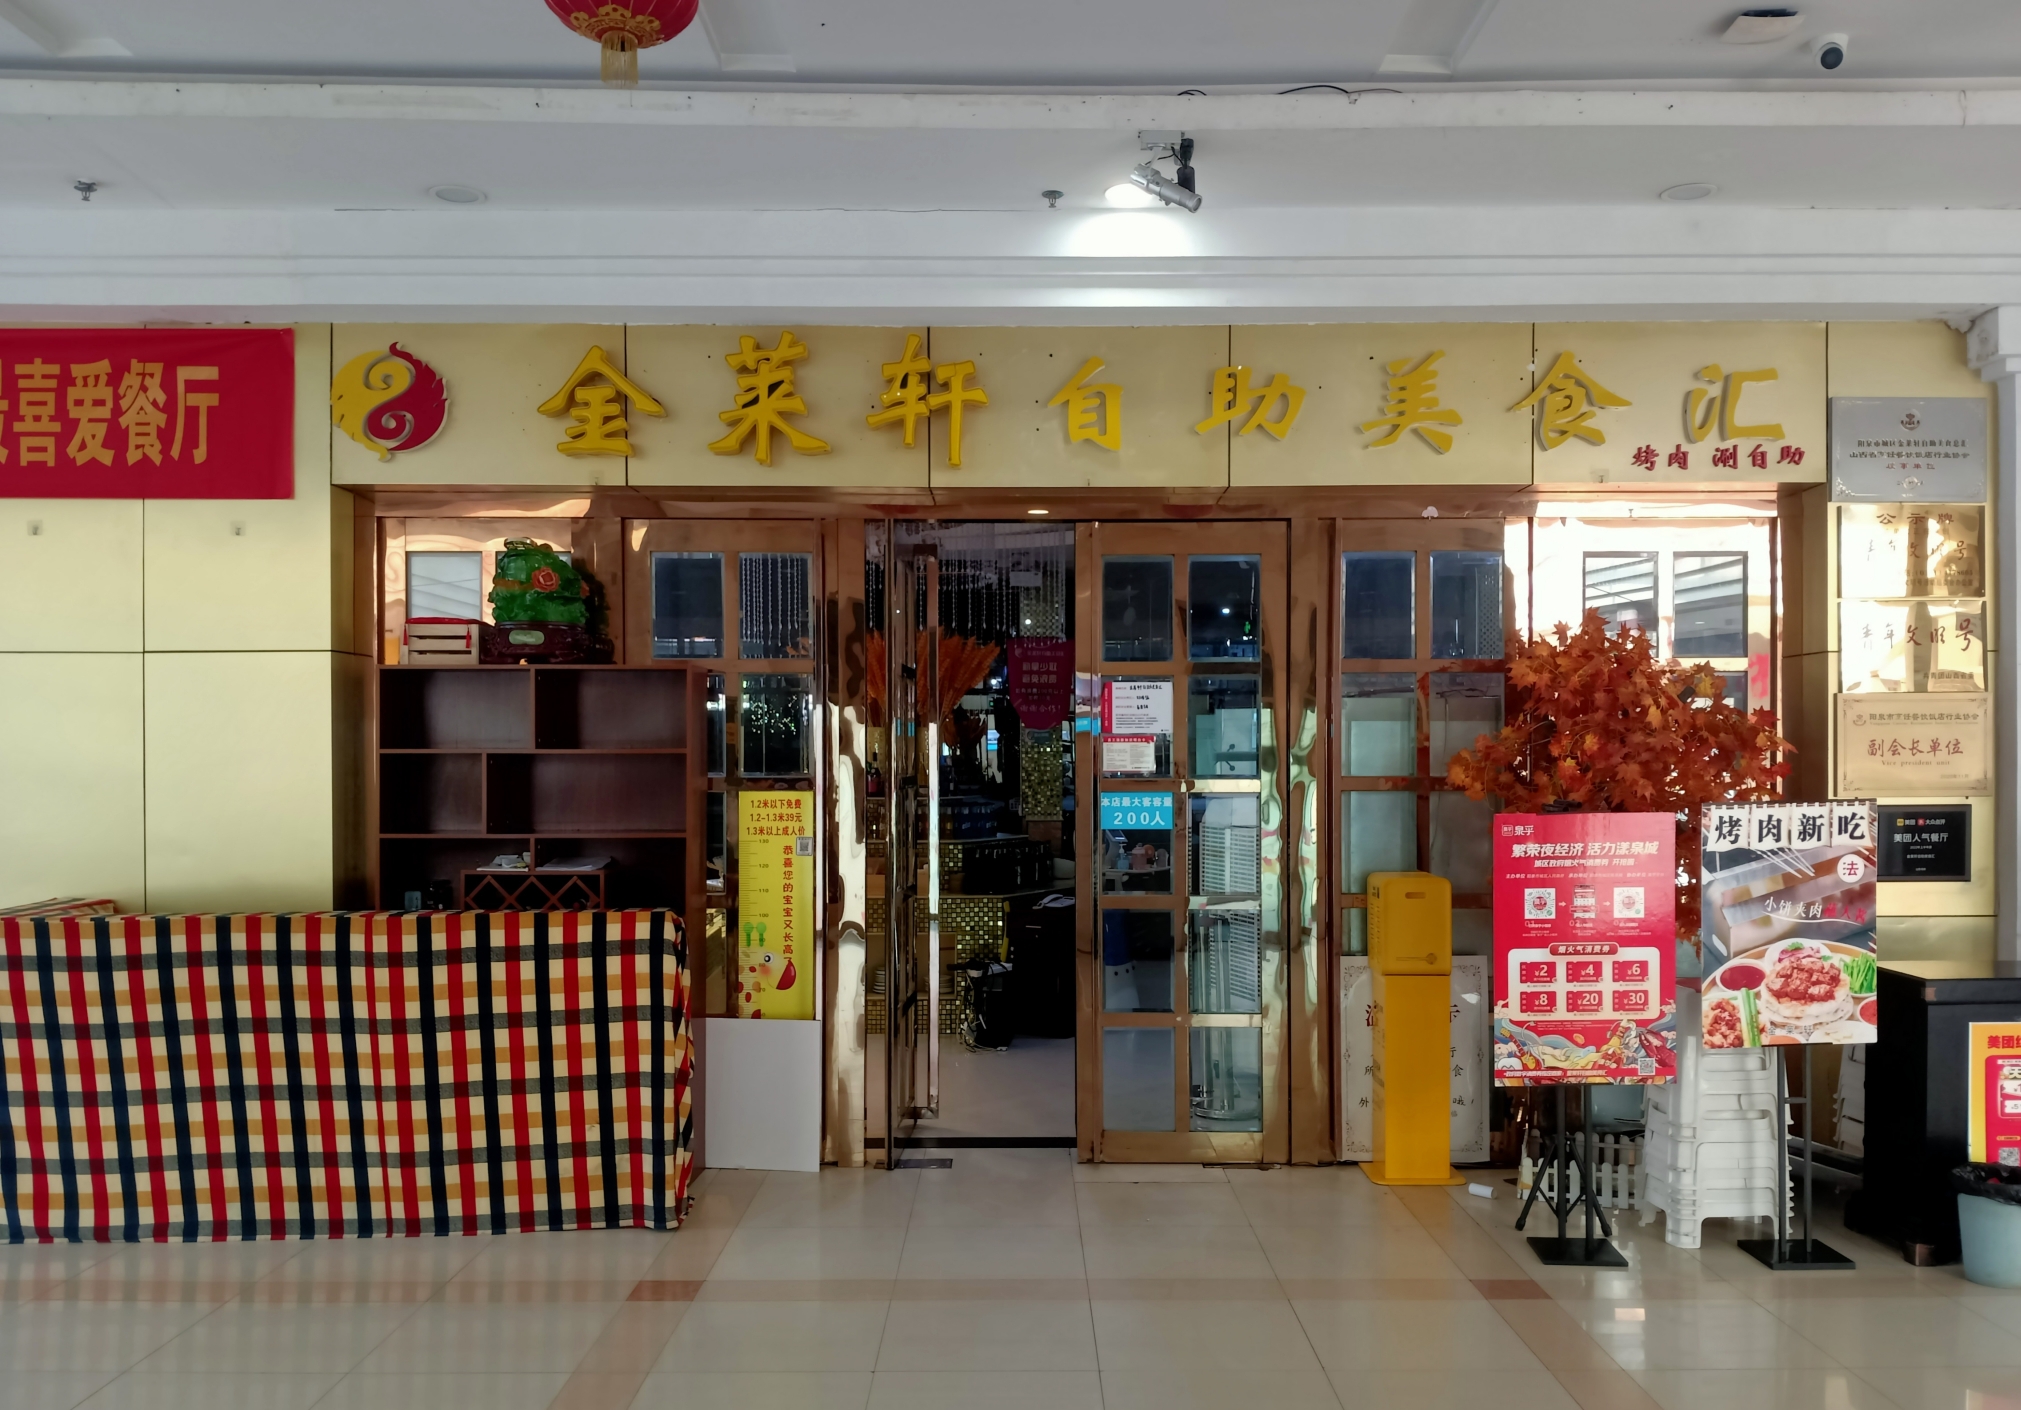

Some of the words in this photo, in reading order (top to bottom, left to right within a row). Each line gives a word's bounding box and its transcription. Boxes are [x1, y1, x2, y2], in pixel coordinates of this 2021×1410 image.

[537, 330, 1787, 469] 金莱轩自助美食汇
[1876, 513, 1954, 525] 公示牌
[1867, 737, 1964, 758] 副会长单位
[751, 799, 802, 809] 1.2米以下免费
[1101, 797, 1173, 807] 本店最大客容量
[750, 813, 802, 822] 1.2-1.3米39元
[1113, 811, 1165, 826] 200人
[747, 826, 806, 836] 1.3米以上成人价
[1514, 825, 1535, 836] 泉乎
[1715, 812, 1866, 844] 烤肉新吃
[1893, 832, 1949, 843] 美团人气餐厅
[1511, 843, 1584, 858] 繁荣夜经济
[1586, 841, 1659, 856] 活力漾泉城
[1842, 861, 1859, 876] 法
